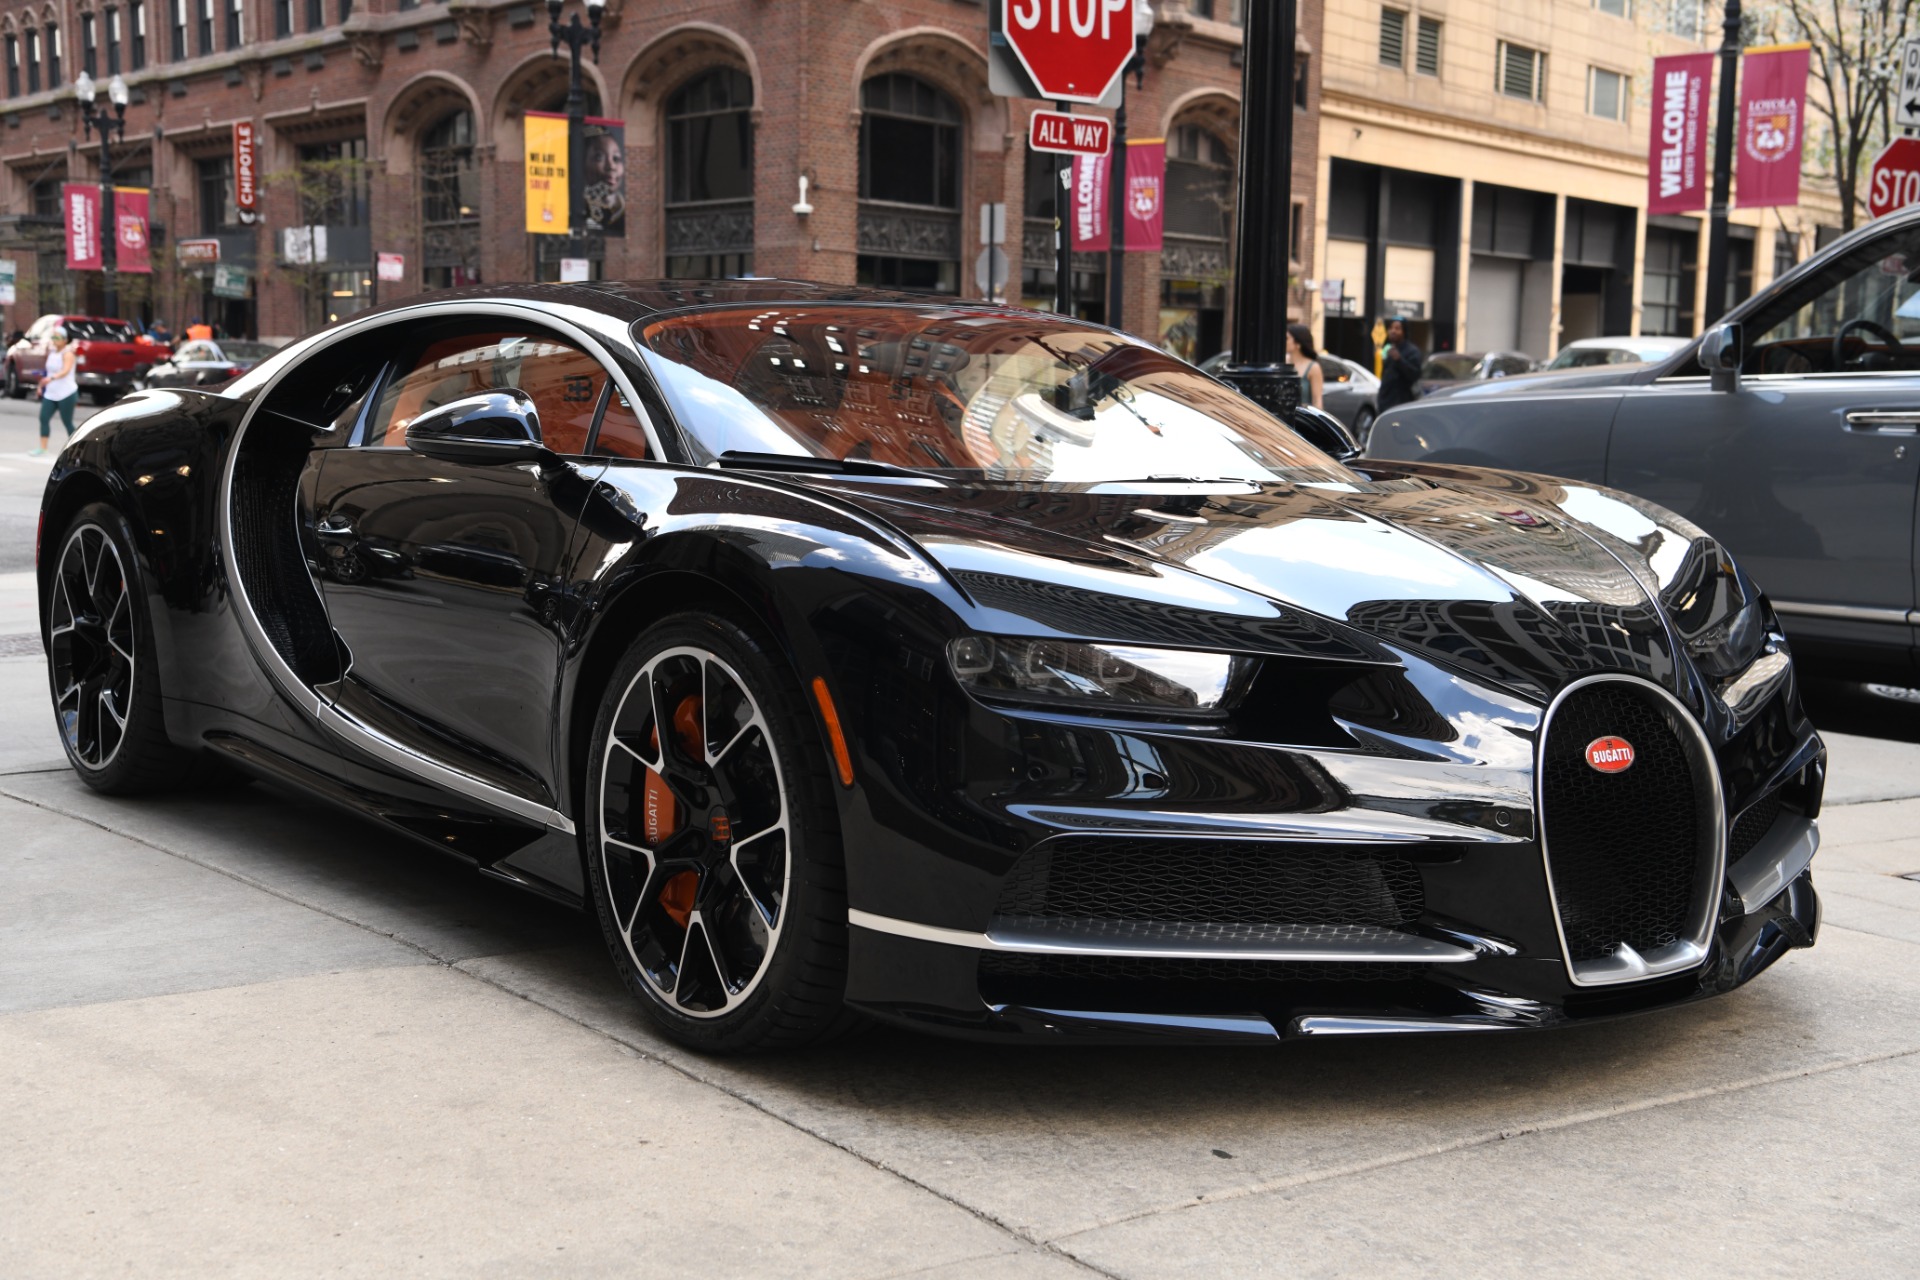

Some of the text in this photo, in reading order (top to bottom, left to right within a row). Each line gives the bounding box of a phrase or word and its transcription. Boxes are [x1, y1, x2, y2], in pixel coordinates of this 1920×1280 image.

[1039, 120, 1102, 148] ALL WAY
[1660, 70, 1688, 198] WELCOME
[1684, 76, 1701, 189] WATER TOWER CAMPUS
[1748, 98, 1797, 111] LOYOLA
[238, 126, 254, 205] CHIPOTLE
[1873, 167, 1920, 208] STO
[71, 193, 88, 261] WELCOME
[1078, 154, 1097, 241] WELCOME
[1592, 748, 1631, 764] BUGATTI
[648, 789, 659, 843] BUGATTI
